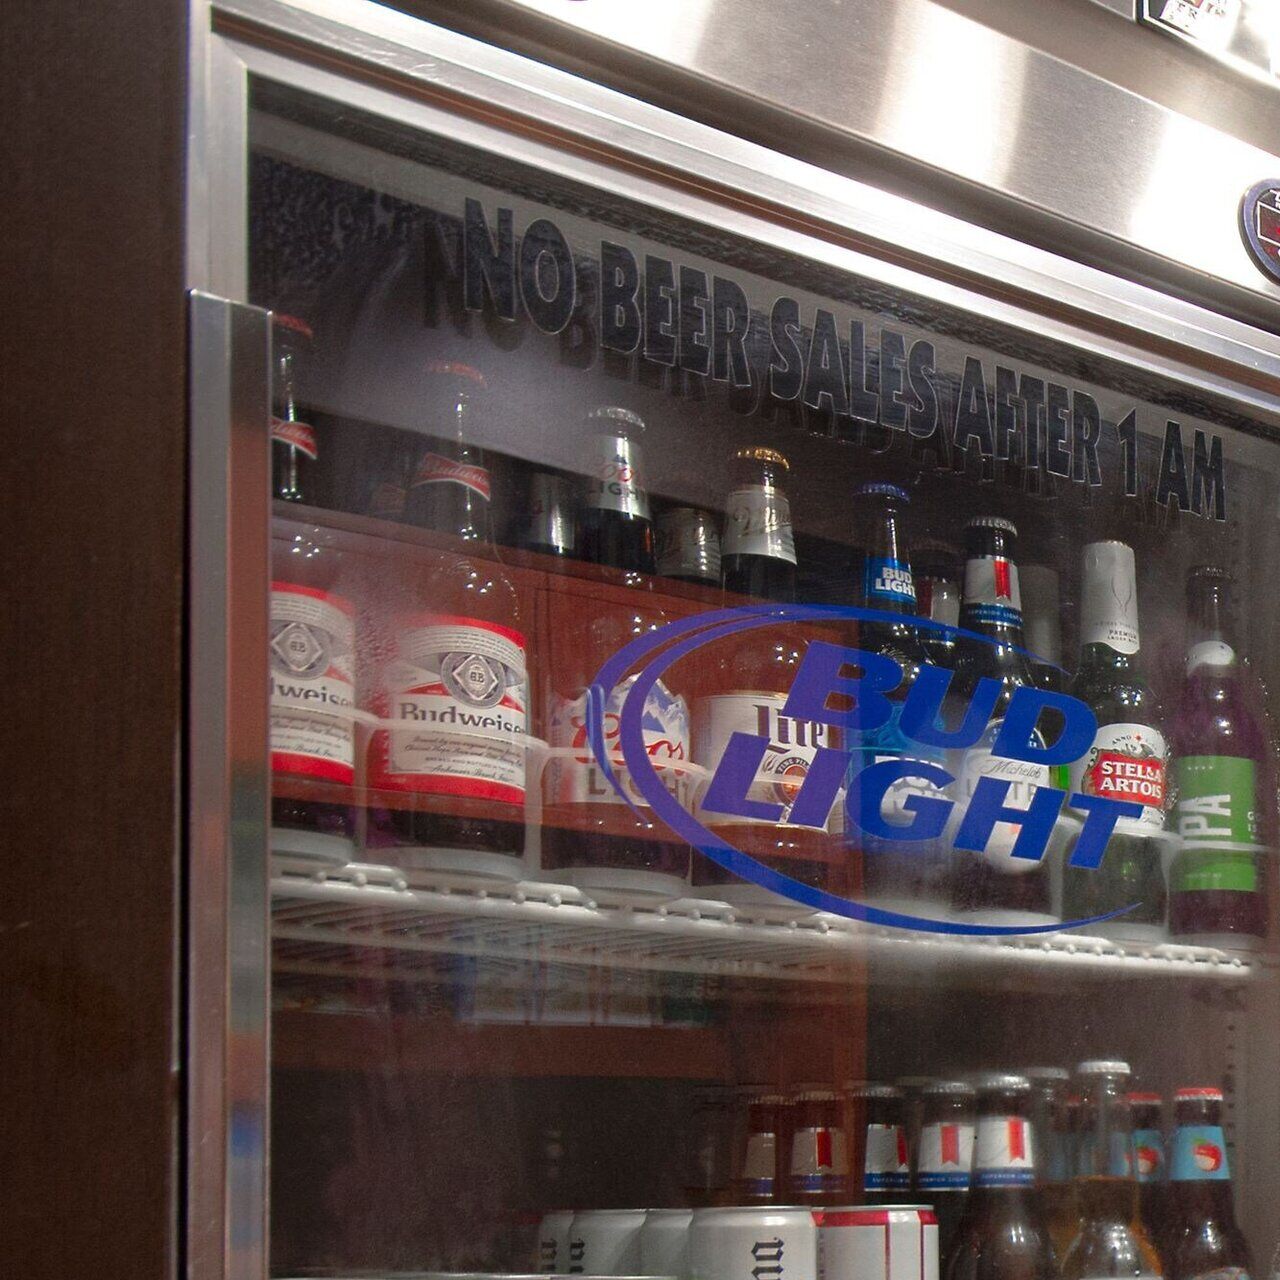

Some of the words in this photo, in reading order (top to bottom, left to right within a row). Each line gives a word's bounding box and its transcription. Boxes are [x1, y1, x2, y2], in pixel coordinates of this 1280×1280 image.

[463, 198, 577, 335] NO
[600, 240, 751, 387] BEER
[769, 295, 938, 439] SALES
[953, 355, 1102, 487] AFTER
[1115, 407, 1138, 497] 1
[1155, 420, 1227, 522] AM
[881, 567, 913, 584] BUD
[781, 639, 1098, 767] BUD
[699, 731, 1144, 870] LIGHT
[1099, 776, 1163, 800] ARTOIS
[1101, 760, 1162, 785] STELLA
